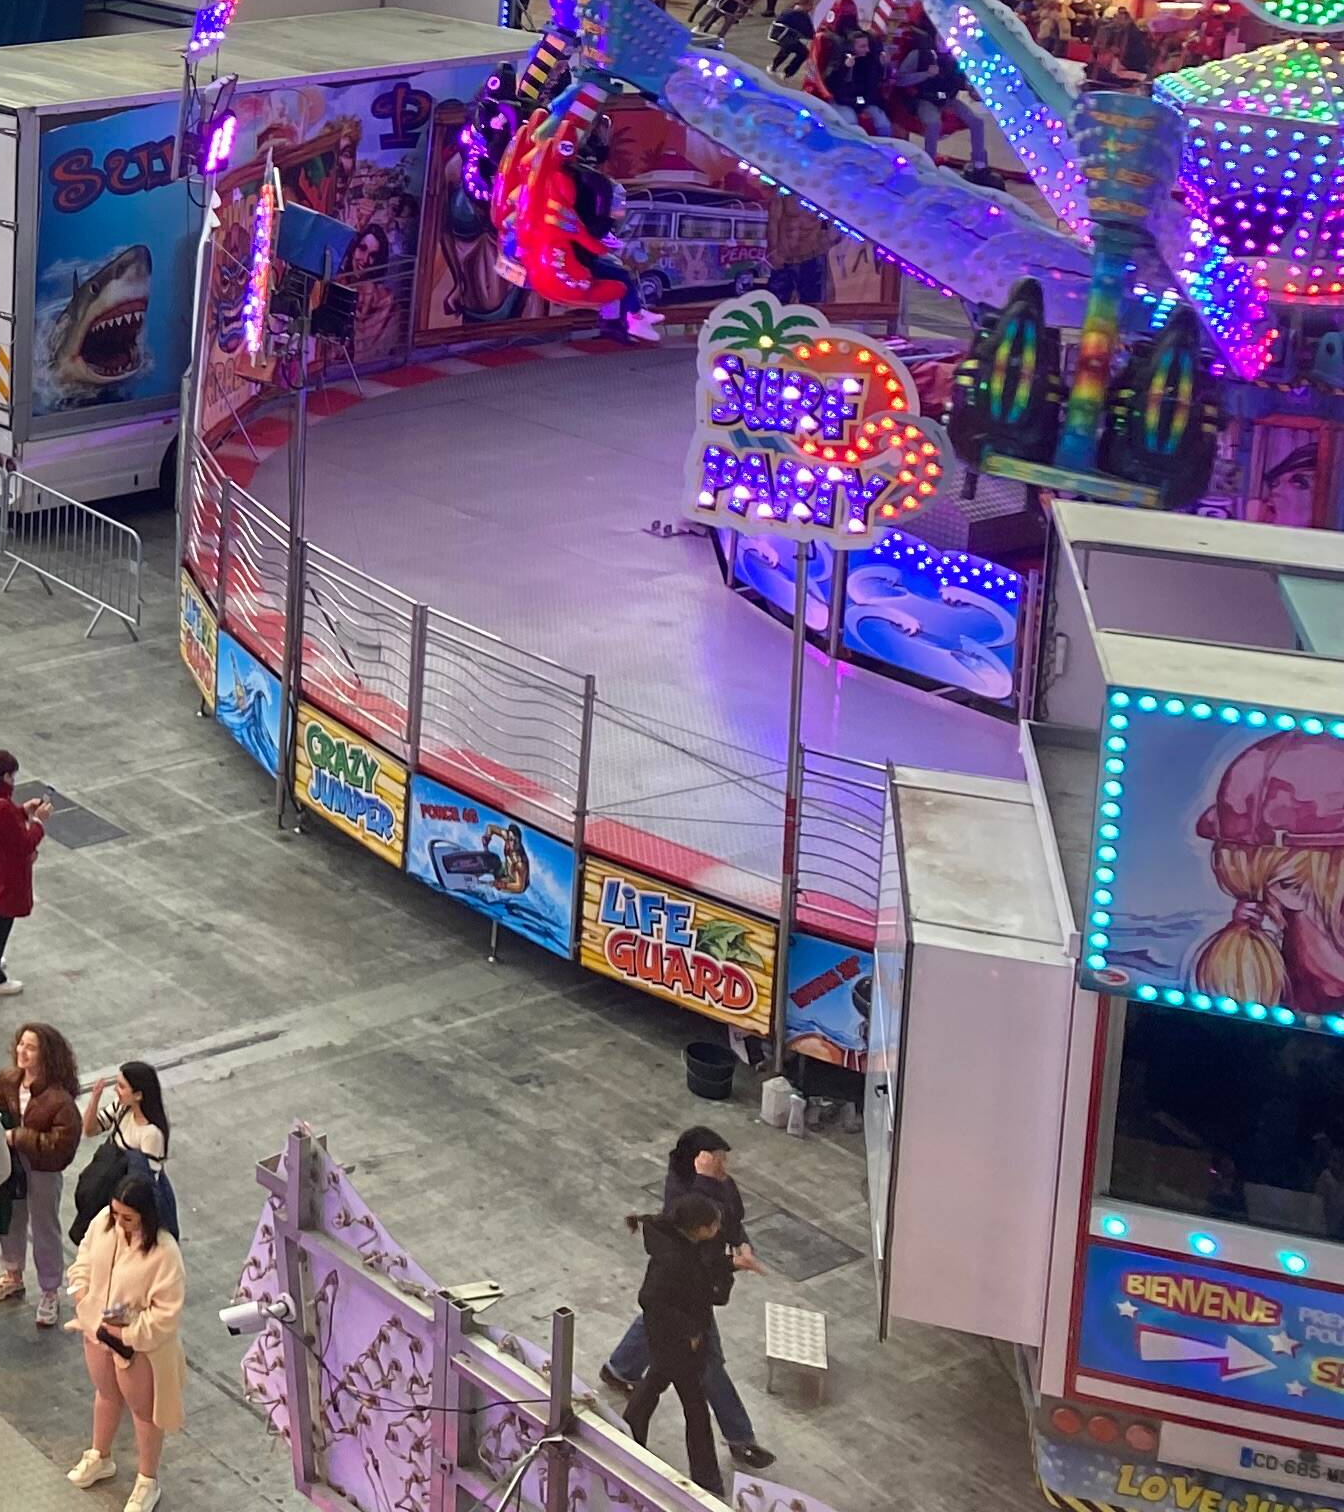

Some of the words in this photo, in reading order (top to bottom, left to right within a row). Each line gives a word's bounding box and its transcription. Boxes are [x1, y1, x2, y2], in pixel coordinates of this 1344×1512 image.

[711, 353, 865, 441] SURF
[697, 444, 891, 534] PARTY
[305, 721, 379, 793] CRAZY
[309, 767, 395, 843] JUMPER
[606, 928, 756, 1013] GUARD
[1126, 1274, 1279, 1323] BIENVENUE
[1116, 1464, 1223, 1512] LOVE
